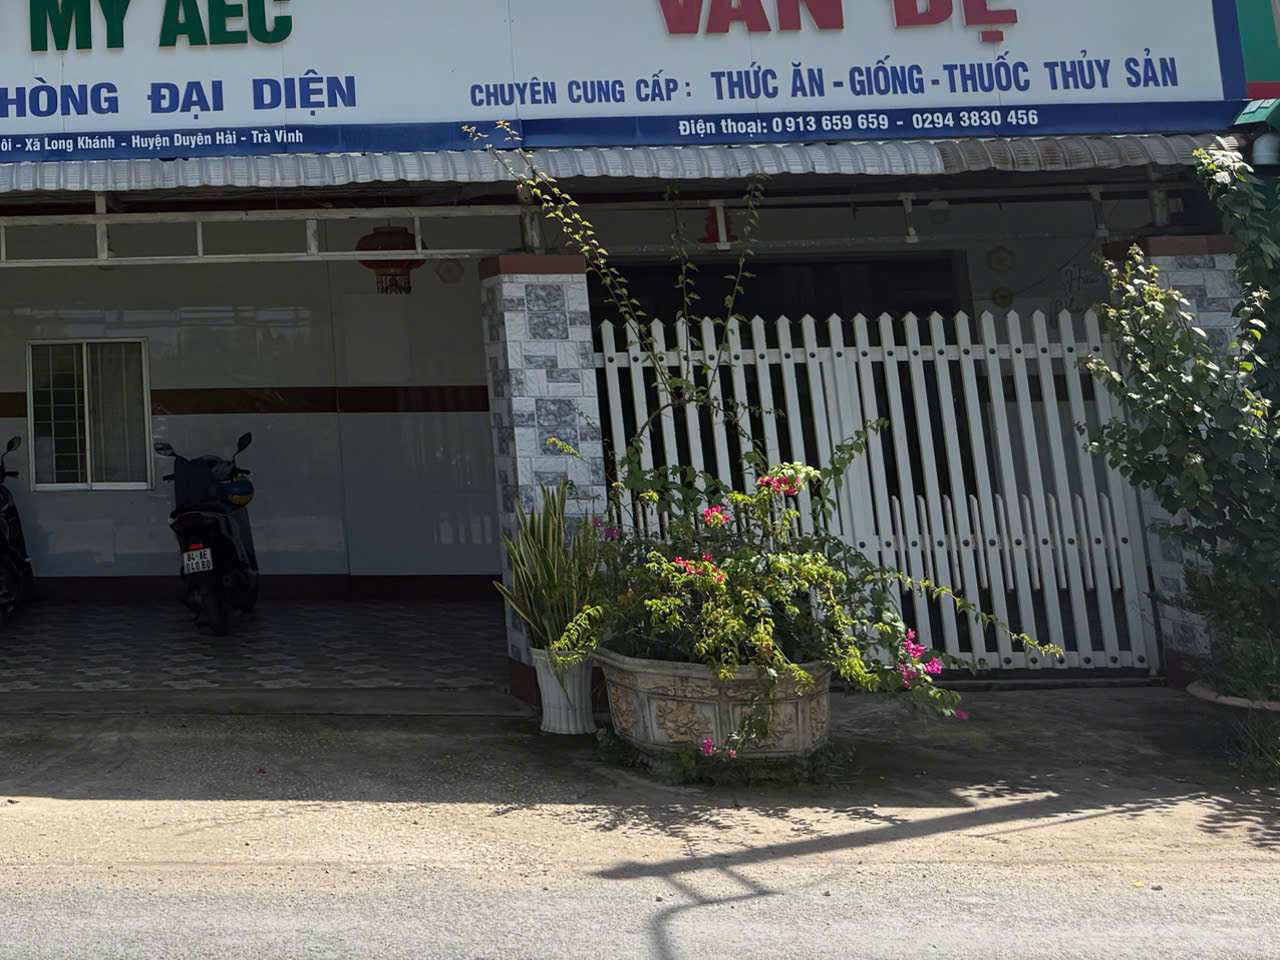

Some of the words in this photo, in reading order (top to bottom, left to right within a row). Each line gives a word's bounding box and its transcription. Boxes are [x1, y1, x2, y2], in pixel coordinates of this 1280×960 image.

[147, 80, 224, 120] ĐẠI
[252, 69, 356, 116] DIỆN
[470, 77, 557, 106] CHUYÊN
[568, 79, 625, 103] CUNG
[710, 61, 779, 100] THỨC
[791, 62, 825, 98] ĂN
[849, 55, 925, 97] GIỐNG
[943, 51, 1030, 94] THUỐC
[1044, 50, 1111, 90] THỦY
[1125, 48, 1178, 88] SẢN
[25, 138, 41, 151] Xã
[44, 137, 73, 152] Long
[77, 135, 115, 149] Khánh
[132, 134, 170, 150] Huyện
[174, 132, 211, 148] Duyên
[216, 130, 237, 145] Hải
[251, 129, 271, 143] Trà
[678, 119, 716, 138] Điện
[720, 119, 768, 137] thoại:
[821, 114, 852, 131] 659
[857, 113, 889, 130] 659
[912, 112, 955, 129] 0294
[959, 110, 1002, 127] 3830
[1007, 109, 1039, 126] 456
